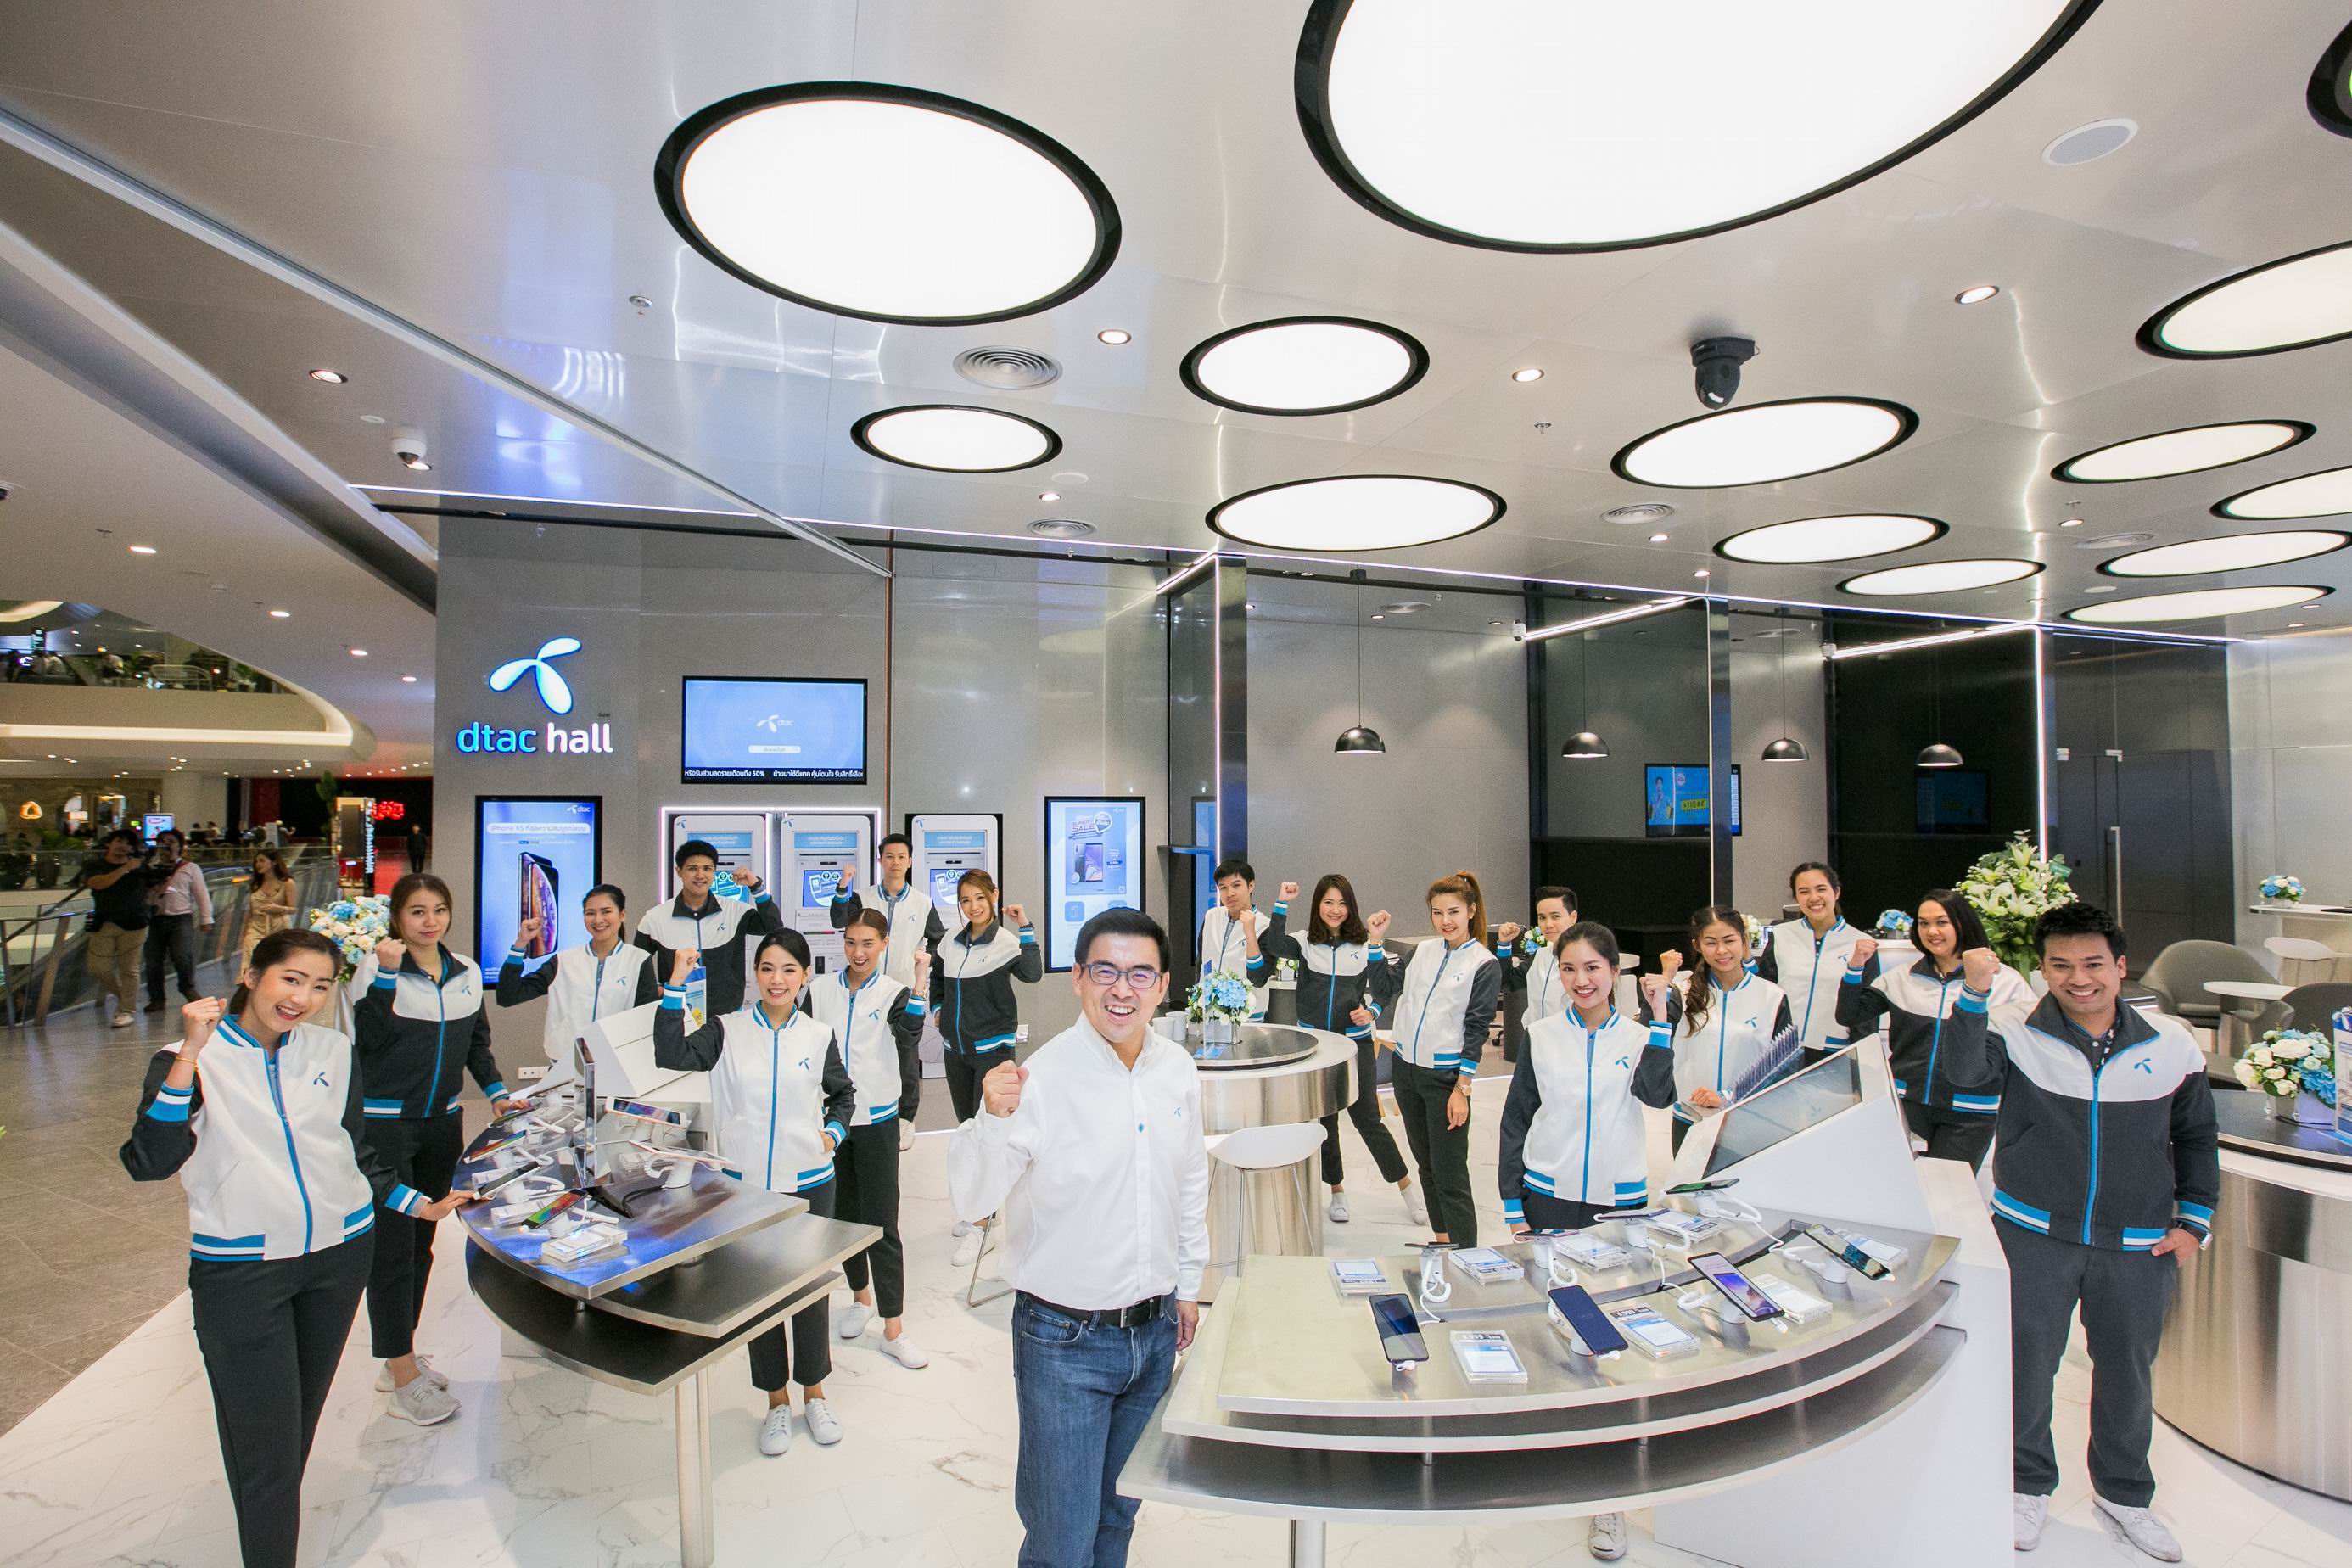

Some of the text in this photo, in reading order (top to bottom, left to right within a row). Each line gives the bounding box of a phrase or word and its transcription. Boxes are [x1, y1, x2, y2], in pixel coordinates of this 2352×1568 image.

[457, 721, 613, 753] dtac hall
[1072, 824, 1095, 832] SALE
